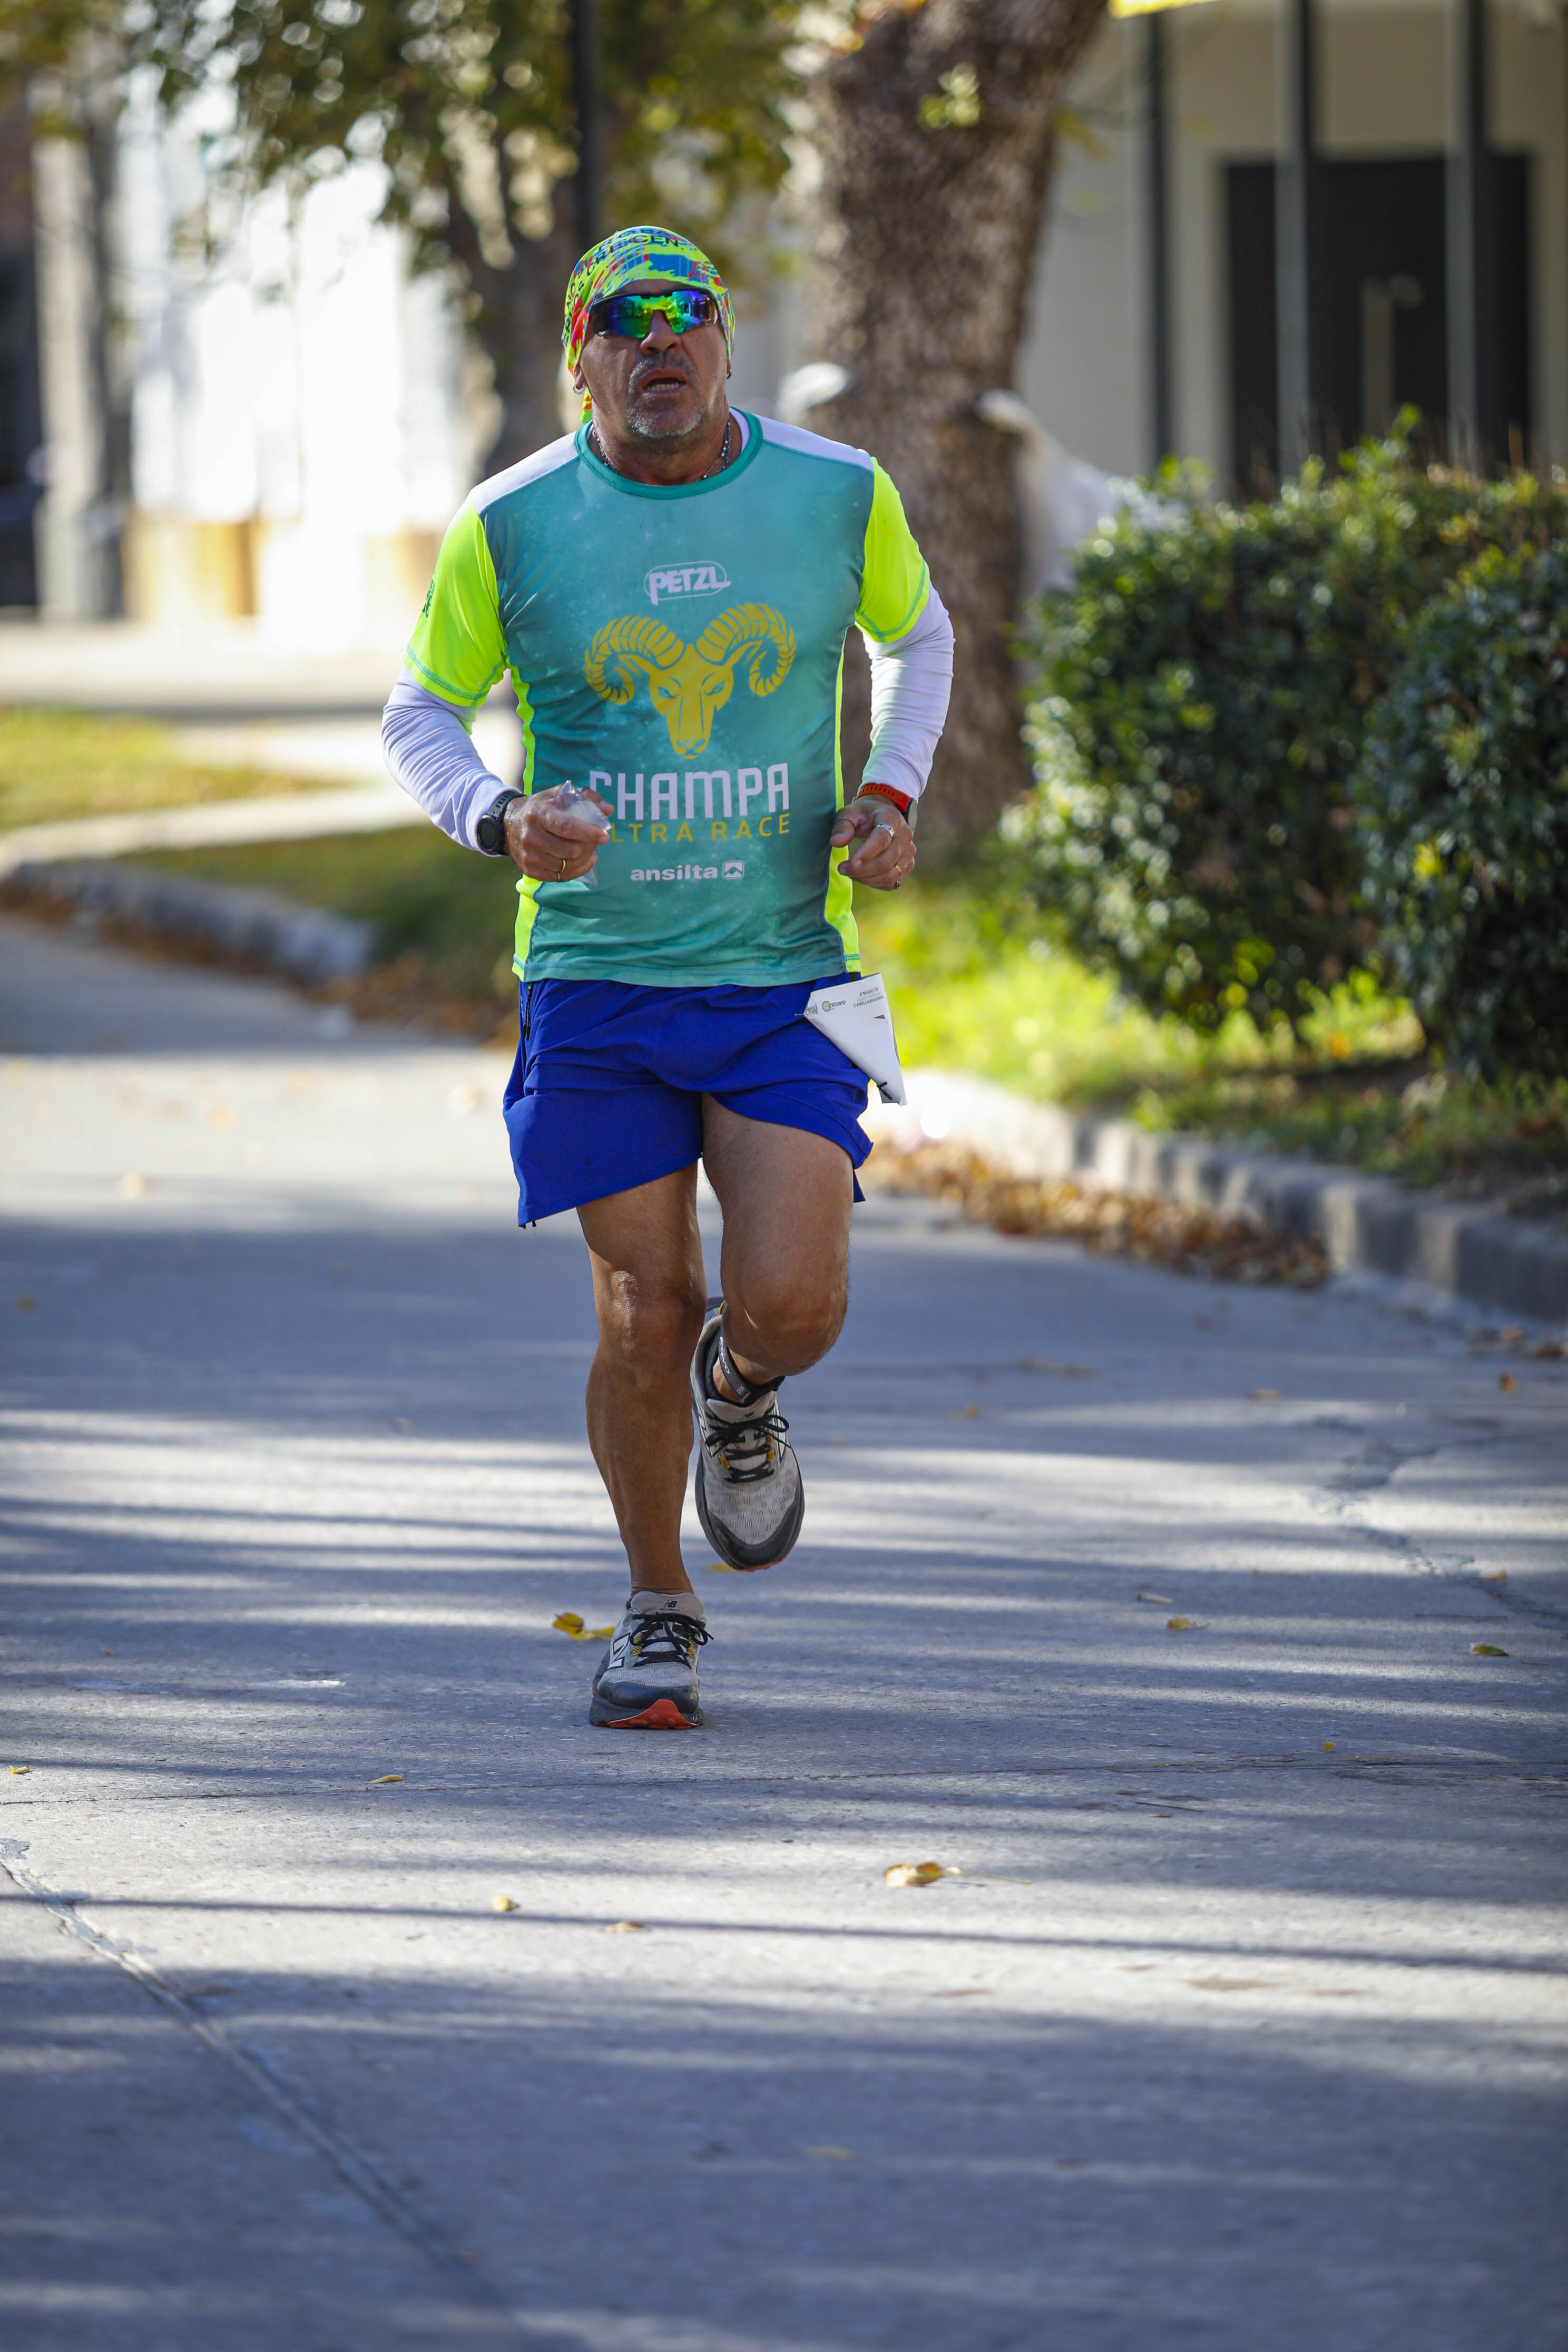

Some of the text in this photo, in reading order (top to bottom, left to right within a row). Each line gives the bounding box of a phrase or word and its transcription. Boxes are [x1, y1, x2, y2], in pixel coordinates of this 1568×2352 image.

[649, 565, 731, 606] PETZL
[611, 813, 790, 843] LTRA RACE
[630, 864, 718, 881] ansilta
